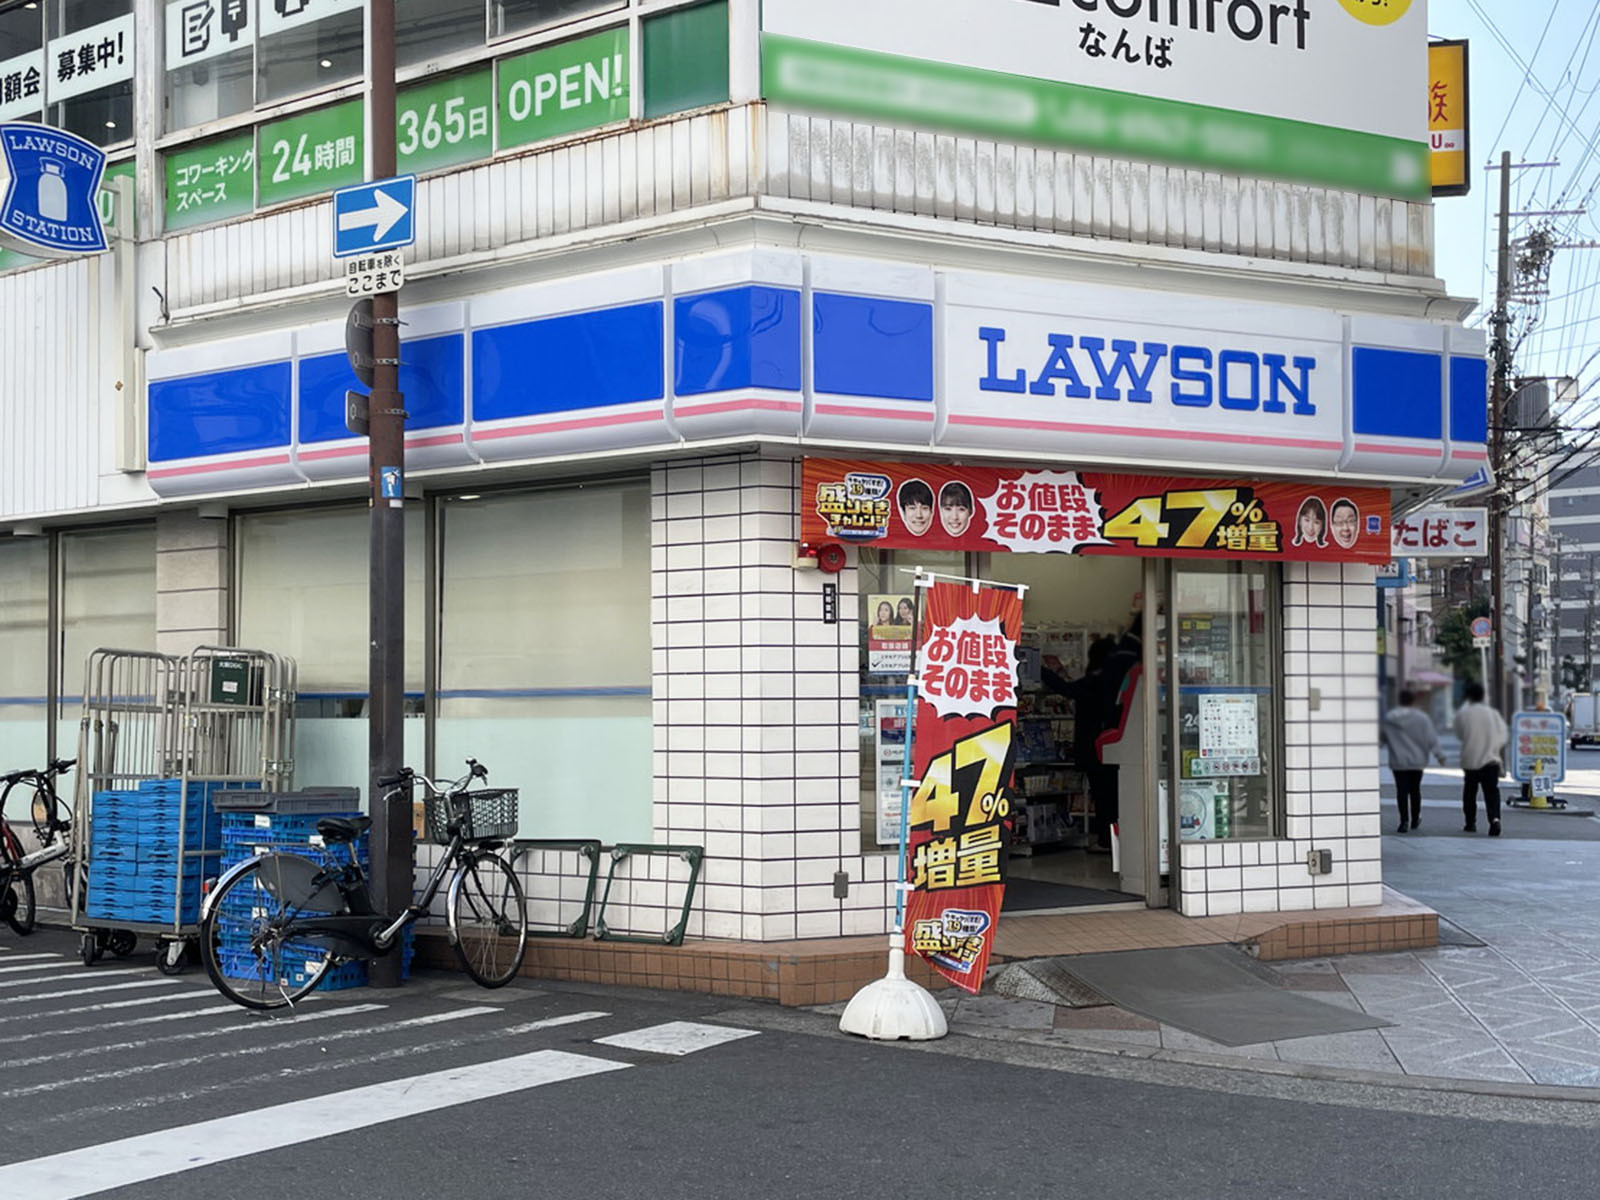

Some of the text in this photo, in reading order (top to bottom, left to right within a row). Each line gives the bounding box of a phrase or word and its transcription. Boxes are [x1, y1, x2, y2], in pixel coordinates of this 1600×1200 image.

[57, 31, 124, 82] 募集中!
[1079, 22, 1174, 68] なんば
[0, 65, 40, 104] 額会
[272, 54, 623, 184] 24時間 365日 OPEN!
[9, 135, 94, 170] LAWSON
[176, 150, 253, 187] コワーキング
[176, 183, 228, 212] スペース
[12, 209, 94, 242] STATION
[348, 269, 401, 294] ここまで
[349, 254, 400, 274] 自転車を除く
[978, 326, 1316, 415] LAWSON
[996, 482, 1092, 513] お値段
[993, 513, 1096, 542] そのまま
[1103, 487, 1263, 547] 47%
[1393, 519, 1477, 547] たばこ
[1216, 520, 1279, 553] 増量
[927, 628, 1010, 669] お値段
[922, 664, 1012, 703] そのまま
[910, 721, 1009, 833] 47%
[913, 824, 1002, 889] 増量
